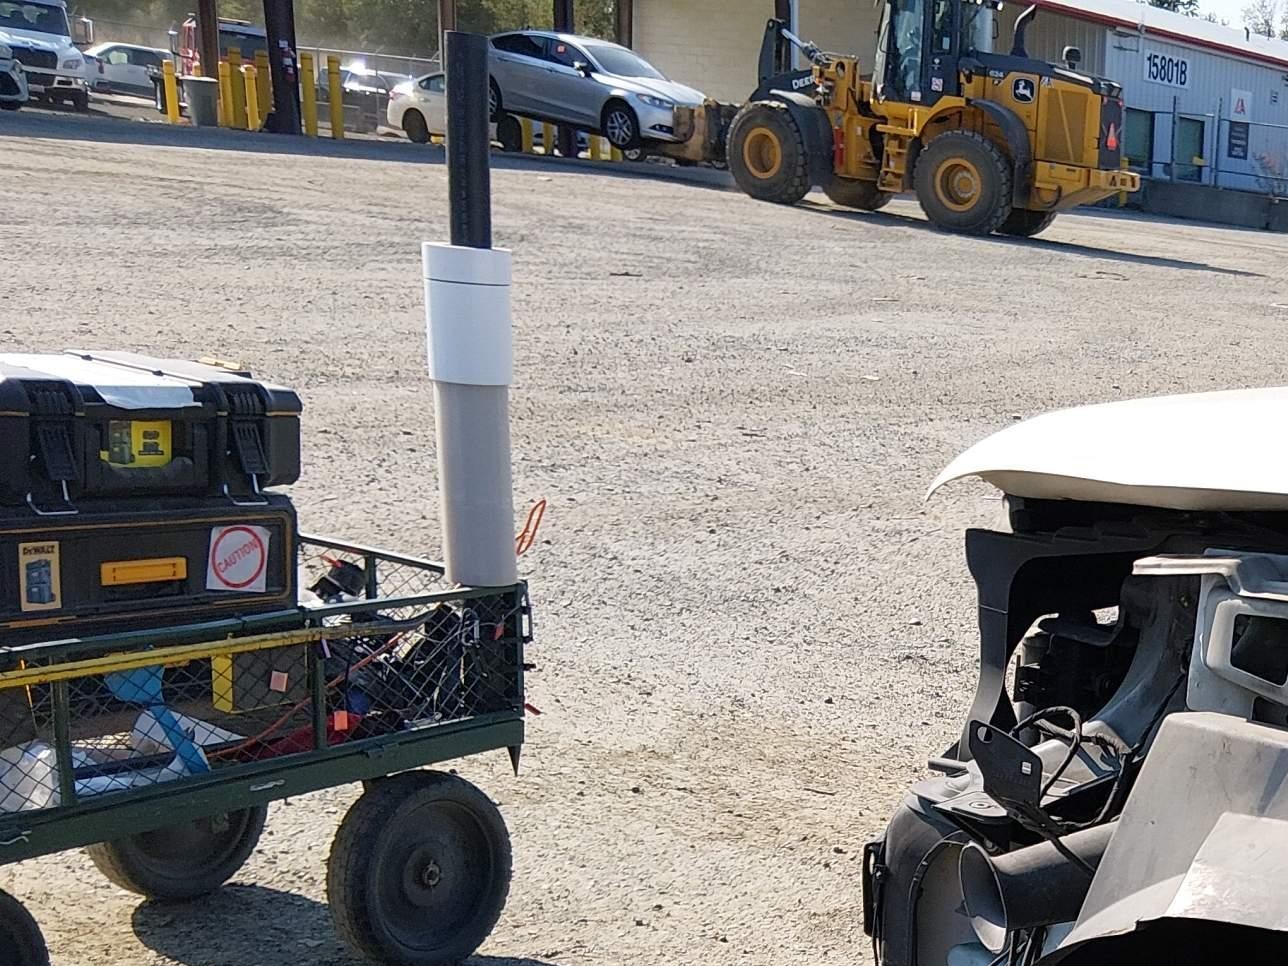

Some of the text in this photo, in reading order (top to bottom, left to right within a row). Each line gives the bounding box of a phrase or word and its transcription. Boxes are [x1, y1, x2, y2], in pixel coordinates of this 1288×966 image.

[792, 75, 816, 90] DEER
[1146, 53, 1188, 86] 15801B
[218, 539, 258, 573] CAUTION
